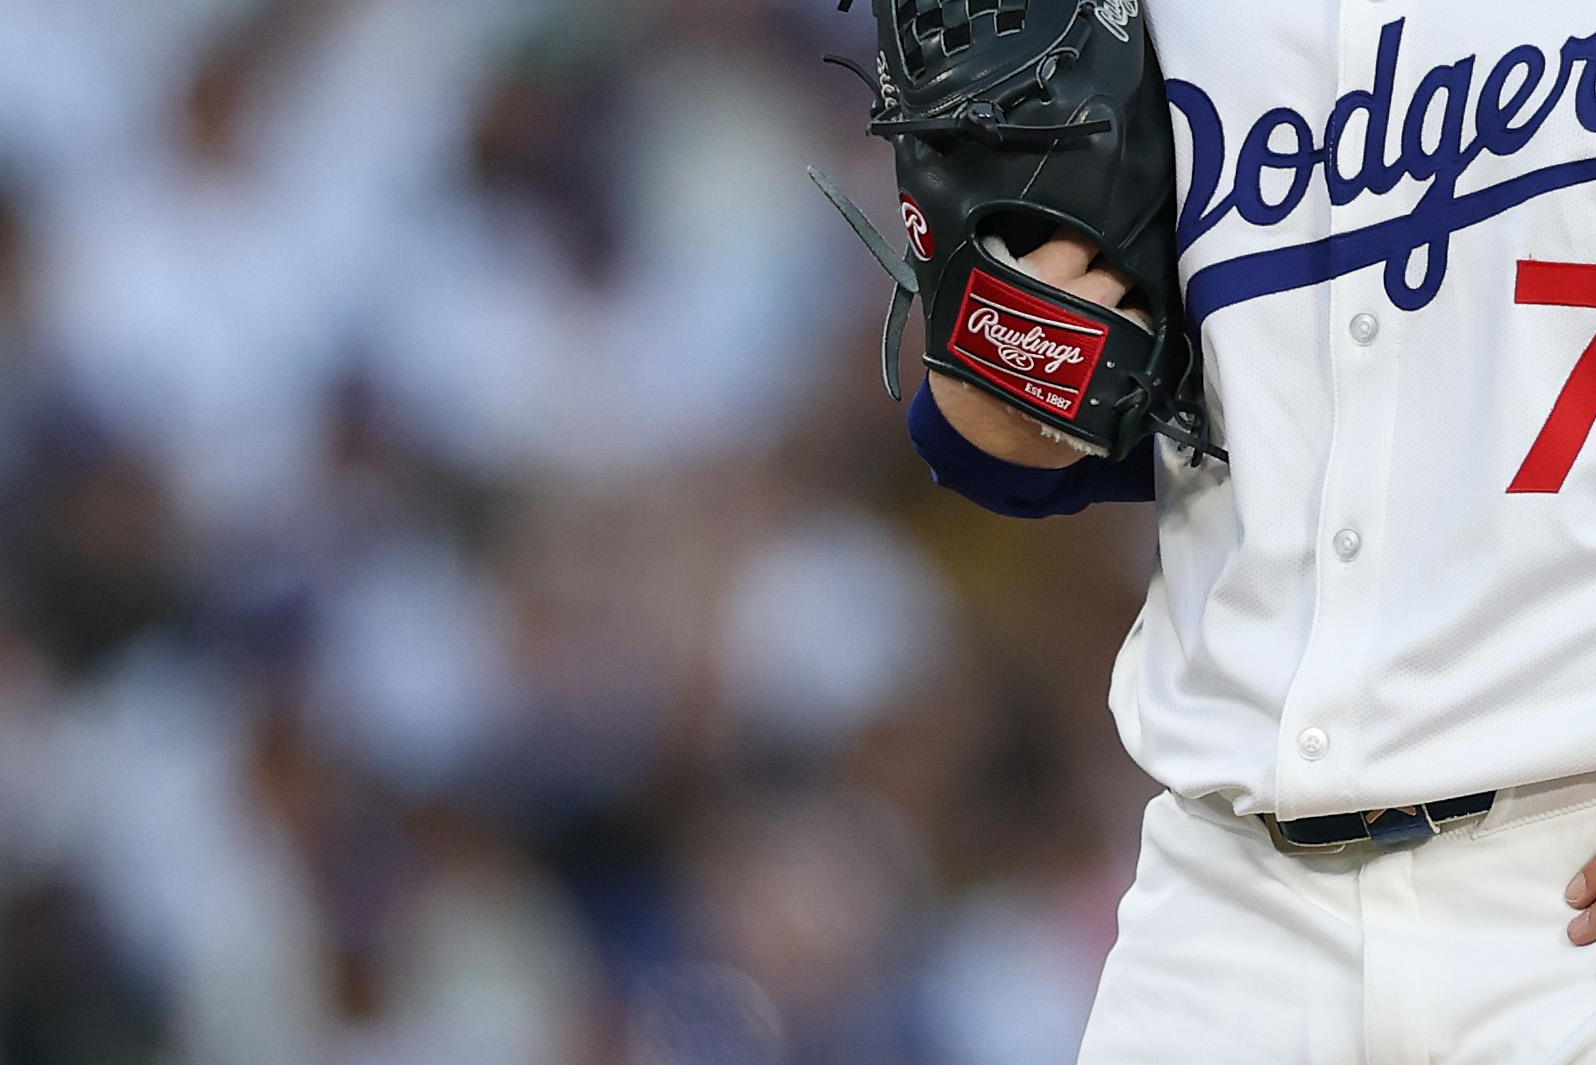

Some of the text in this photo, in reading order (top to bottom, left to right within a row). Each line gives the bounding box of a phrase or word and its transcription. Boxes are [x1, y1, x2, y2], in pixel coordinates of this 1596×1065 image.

[902, 201, 927, 256] R
[967, 307, 1084, 373] Rawlings
[1024, 383, 1072, 410] Est. 1887
